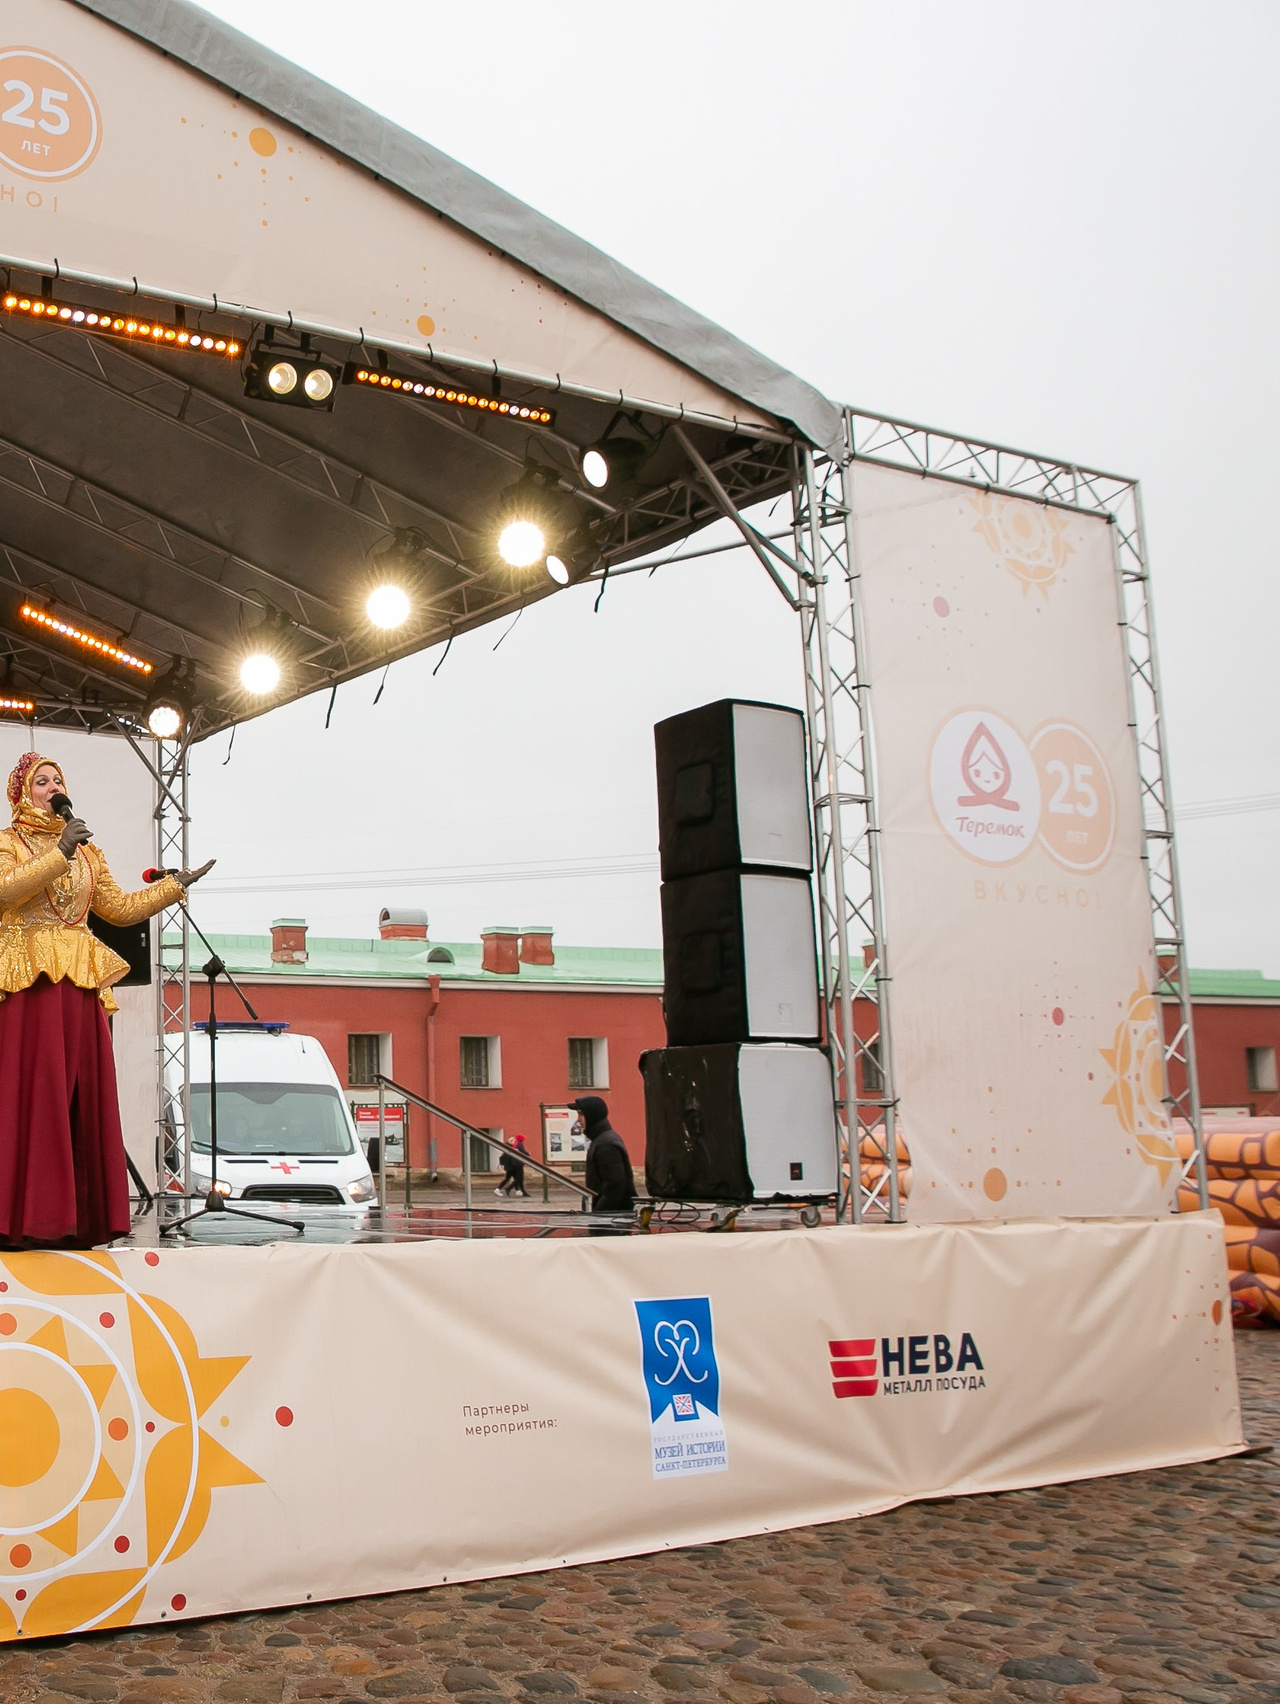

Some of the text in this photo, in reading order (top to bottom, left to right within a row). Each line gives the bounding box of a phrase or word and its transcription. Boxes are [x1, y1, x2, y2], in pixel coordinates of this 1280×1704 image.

[1, 79, 70, 136] 25
[21, 140, 51, 156] ЛЕТ
[1045, 759, 1100, 819] 25
[955, 816, 1026, 838] Теремок
[881, 1333, 985, 1378] НЕВА
[883, 1375, 987, 1395] МЕТАЛЛ ПОСУДА
[462, 1403, 530, 1419] Партнеры
[465, 1418, 558, 1437] мероприятия:
[655, 1440, 726, 1460] МУЗЕЙ ИСТОРИИ
[655, 1456, 727, 1473] САНКТ-ПЕТЕРБУРГА
